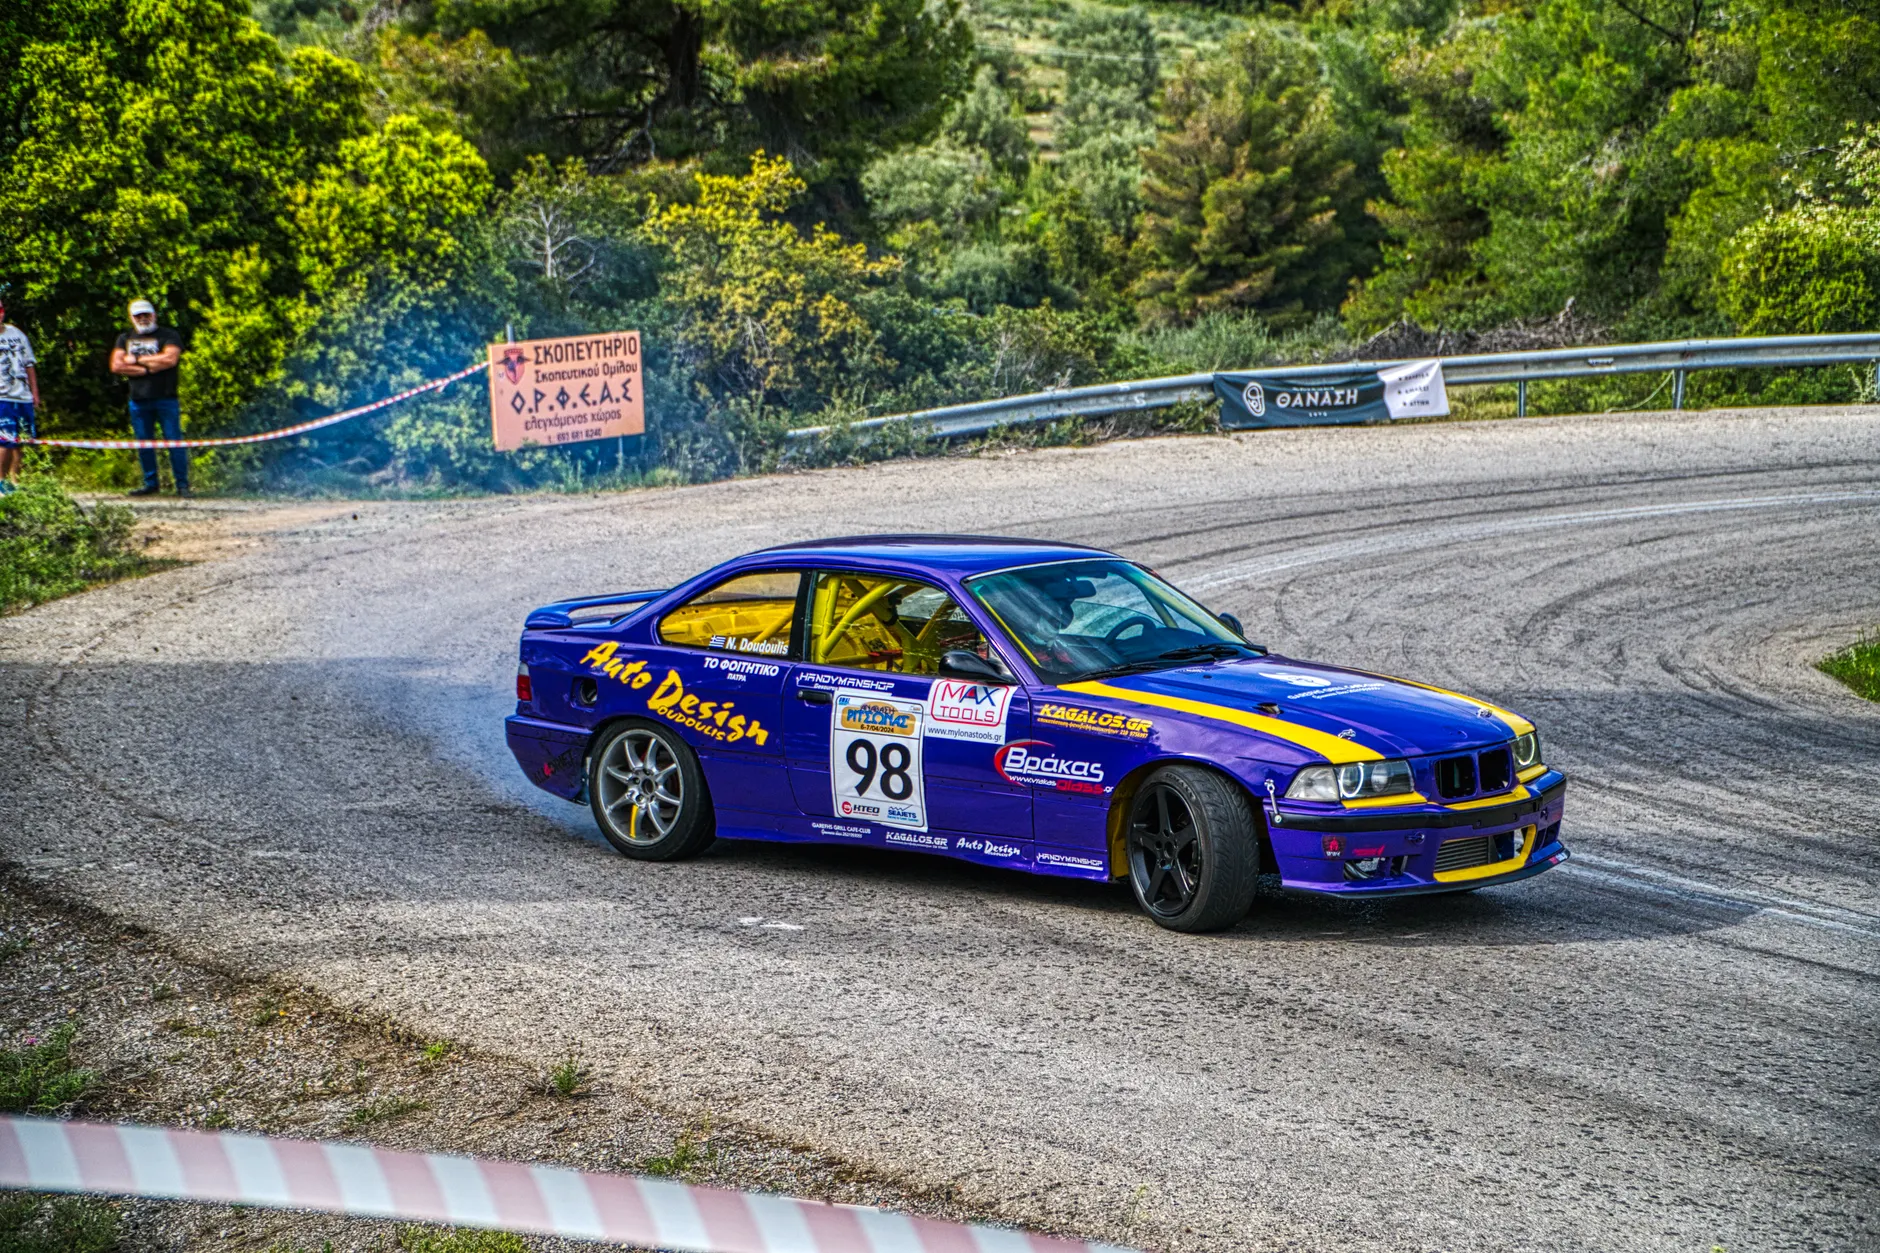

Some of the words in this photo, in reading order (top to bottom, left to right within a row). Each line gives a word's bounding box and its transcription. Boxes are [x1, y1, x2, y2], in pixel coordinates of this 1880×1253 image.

[534, 336, 637, 365] ΣΚΟΠΕΥΤΗΡΙΟ
[535, 366, 600, 383] Σκοπευτικού
[602, 360, 638, 378] Ομίλου
[1276, 388, 1358, 408] ΘΑΝΑΣΗ
[524, 413, 589, 431] ελεγχόμενος
[591, 408, 622, 424] χώρος
[726, 637, 736, 650] N.
[739, 638, 789, 655] Doudoulis
[703, 657, 719, 669] ΤΟ
[720, 659, 779, 676] ΦΟΙΤΗΤΙΚΟ
[727, 673, 746, 682] ΠΑΤΡΑ
[799, 672, 895, 690] HANDYMANSHOP
[580, 640, 652, 689] Auto
[647, 669, 768, 745] Design
[941, 683, 999, 706] MAX
[940, 705, 995, 722] TOOLS
[1040, 704, 1153, 732] KAGALOS.GR
[928, 727, 1002, 742] www.mylonastools.gr
[846, 738, 914, 800] 98
[1004, 747, 1104, 782] Βράκας
[888, 809, 917, 819] SEAJETS
[886, 831, 948, 846] KAGALOS.GR
[956, 837, 983, 850] Auto
[984, 840, 1020, 856] Design
[1038, 853, 1103, 866] HANDYMANSHOP
